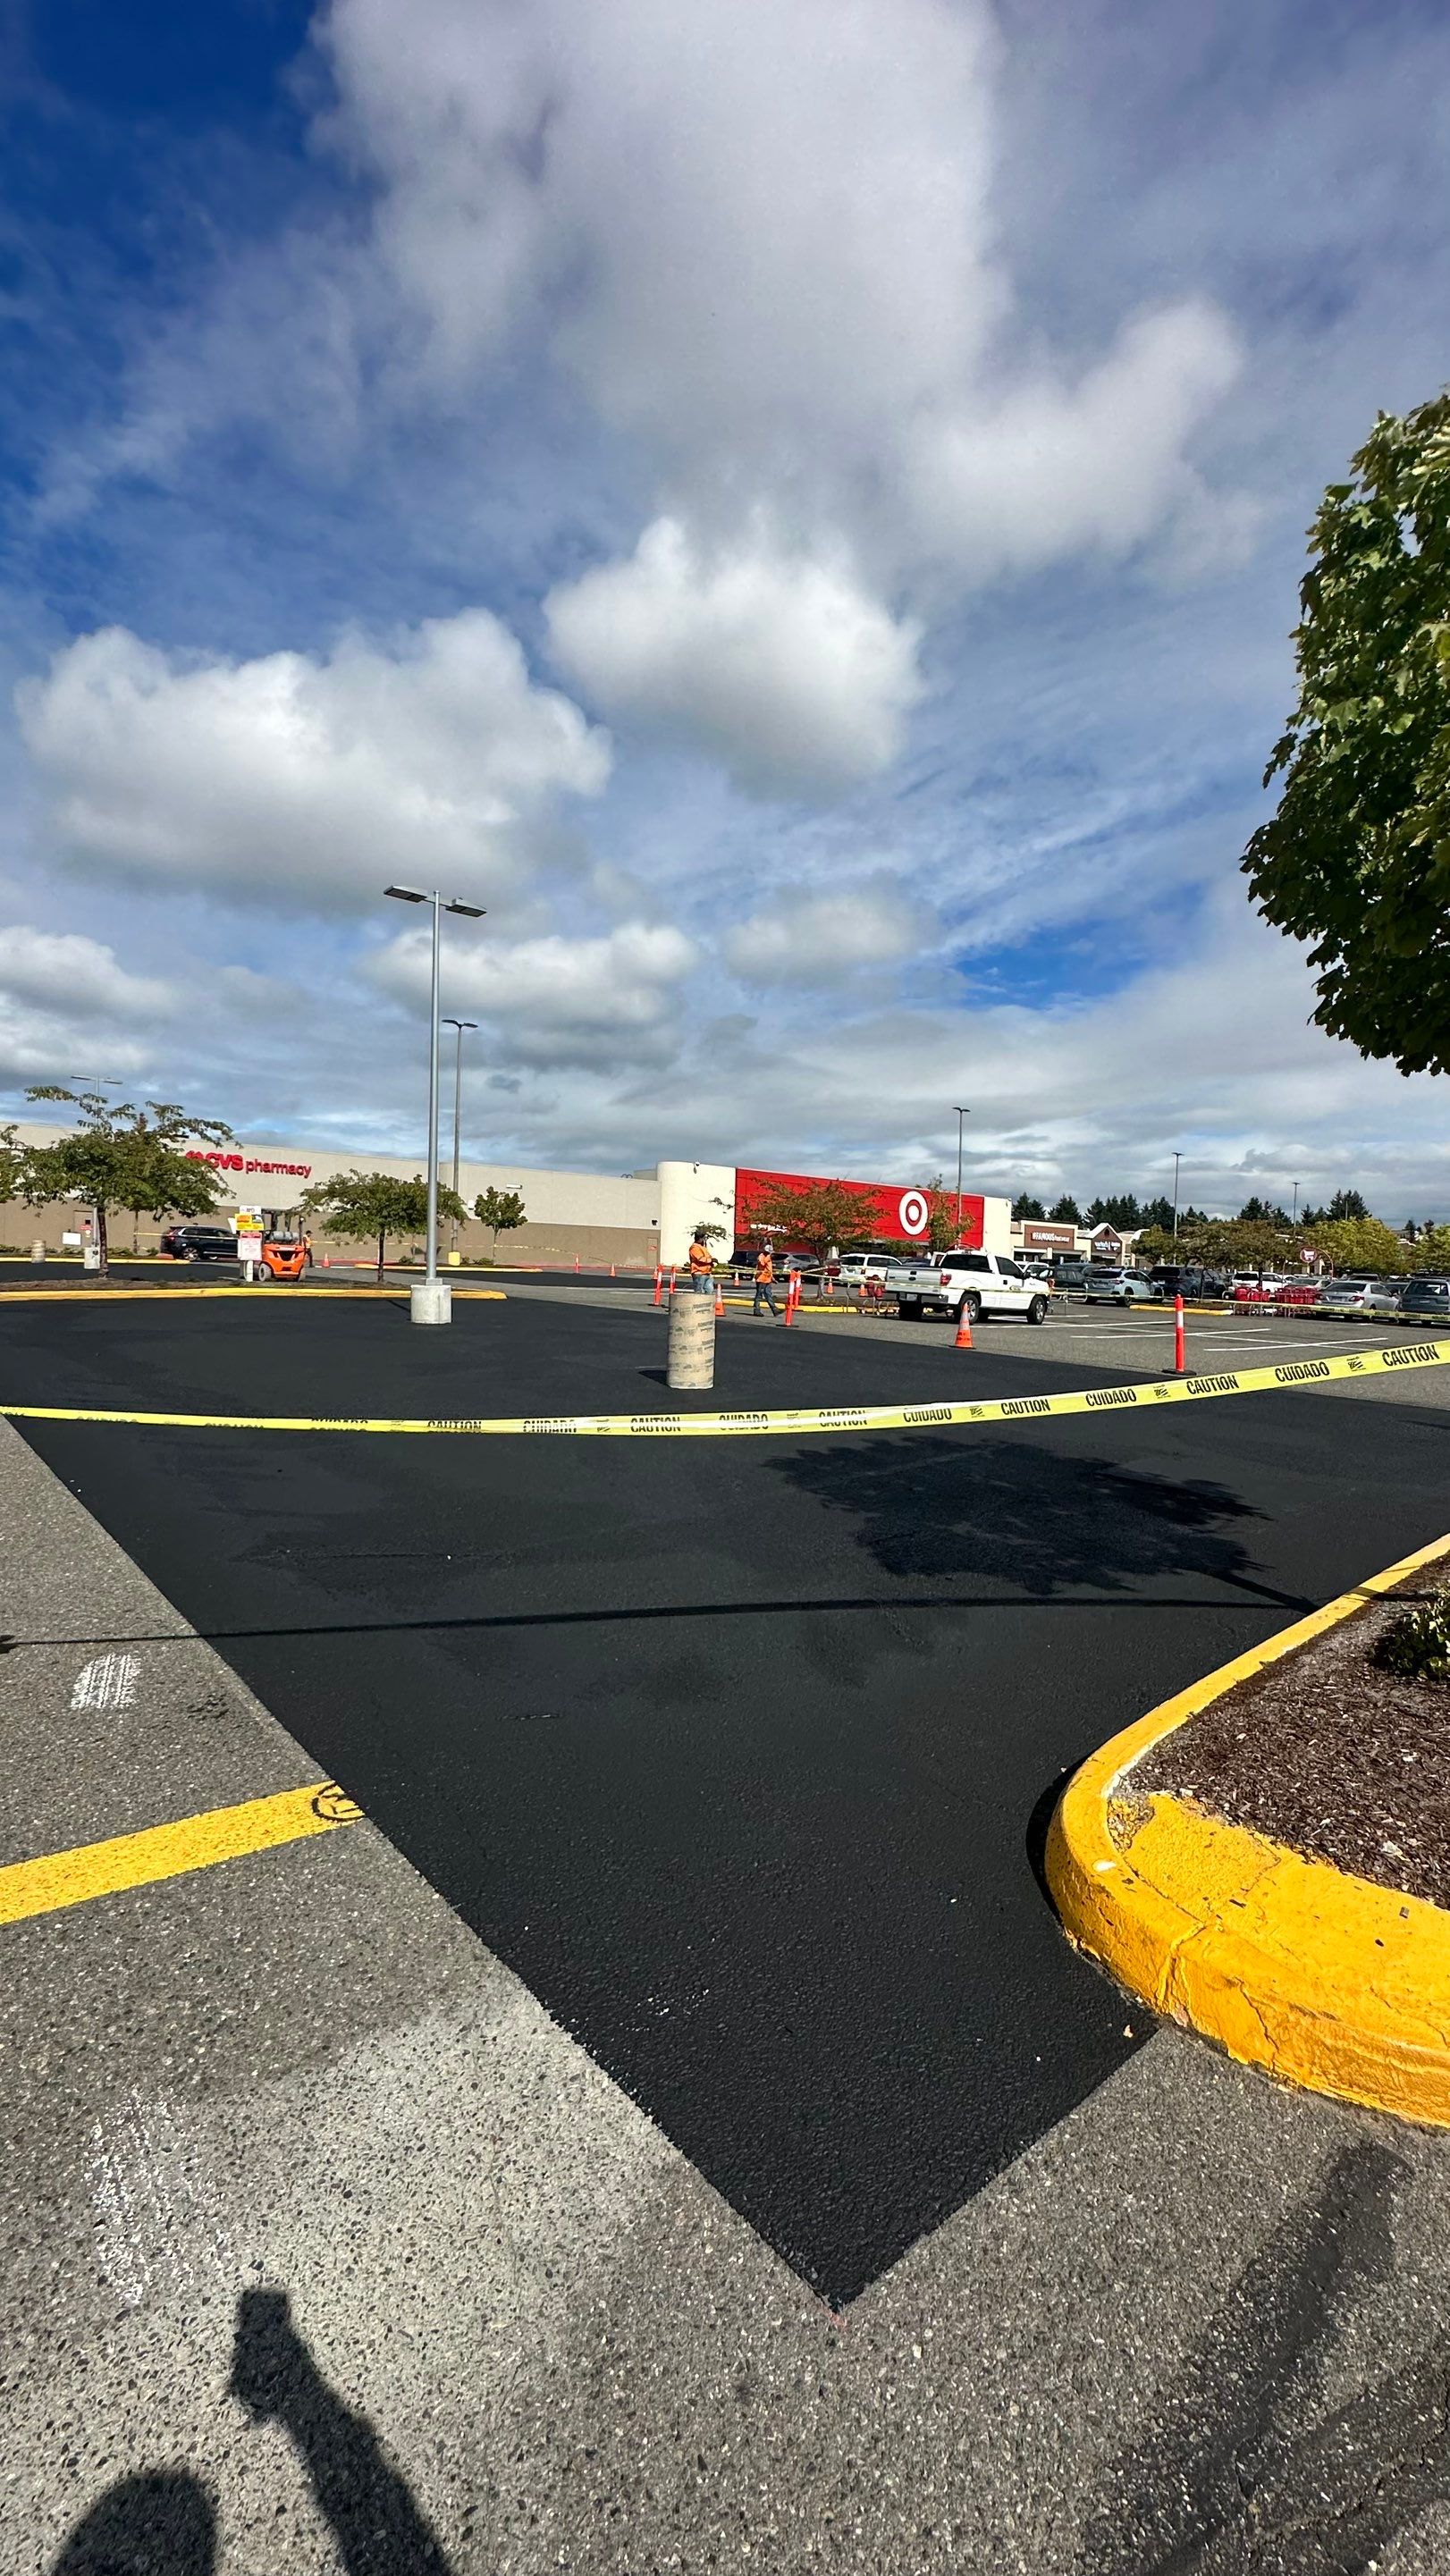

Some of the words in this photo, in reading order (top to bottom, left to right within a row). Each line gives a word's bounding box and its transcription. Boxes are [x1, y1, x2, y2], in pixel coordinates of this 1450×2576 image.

[206, 1152, 243, 1171] CVS
[246, 1158, 312, 1179] pharmacy
[631, 1417, 681, 1433] CAUTION
[719, 1413, 769, 1430] CUIDADO
[818, 1410, 868, 1427] CAUTION
[903, 1408, 953, 1423] CUIDADO
[1000, 1398, 1051, 1416] CAUTION
[1085, 1388, 1137, 1407] CUIDADO
[1185, 1374, 1239, 1395] CAUTION
[1274, 1361, 1330, 1383] CUIDADO
[1381, 1344, 1440, 1367] CAUTION
